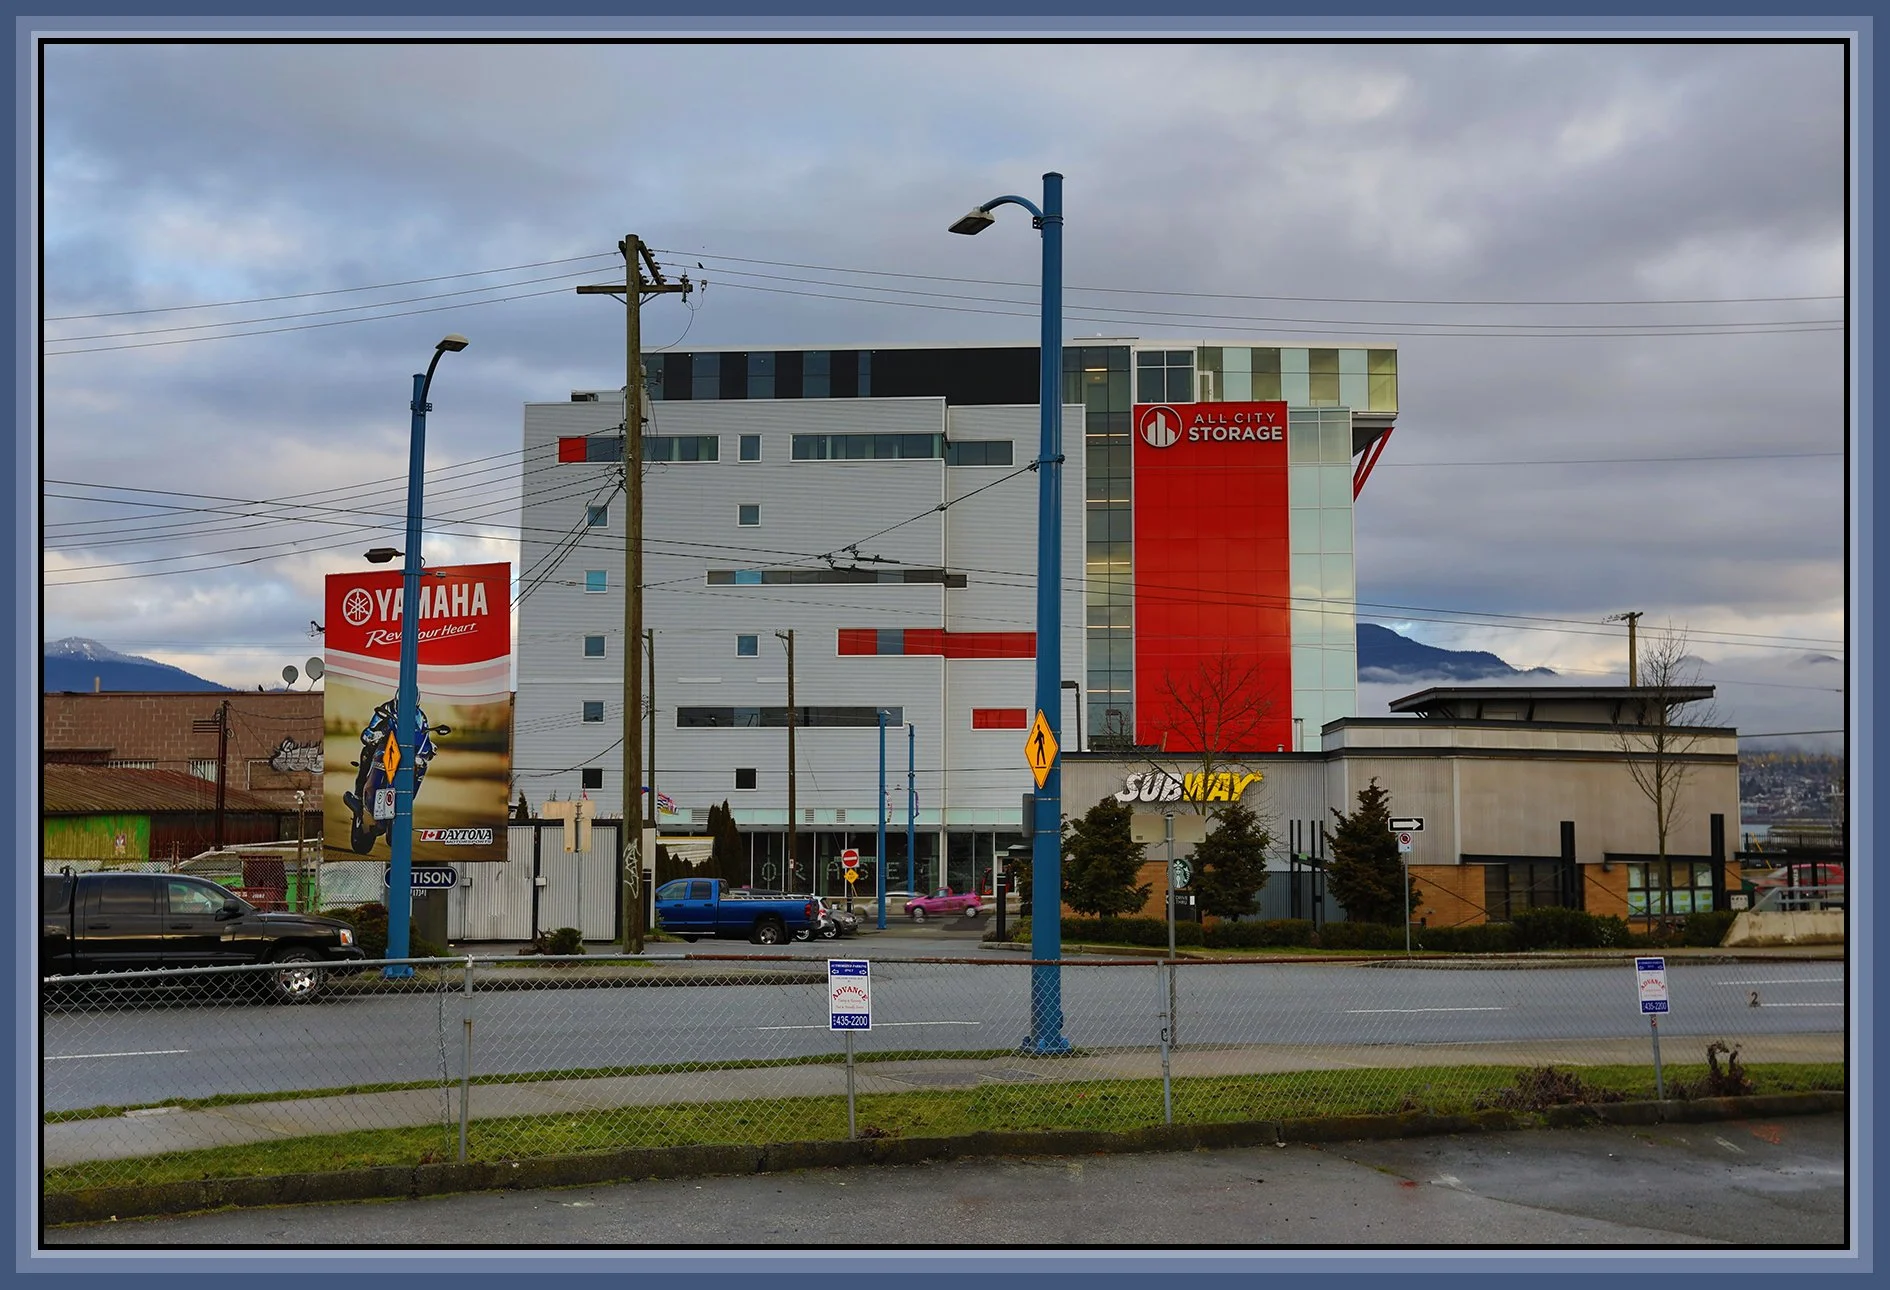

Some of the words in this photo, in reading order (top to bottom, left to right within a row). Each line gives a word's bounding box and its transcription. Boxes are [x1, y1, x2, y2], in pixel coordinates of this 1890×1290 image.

[1194, 413, 1227, 424] ALL
[1234, 412, 1276, 423] CITY
[1188, 425, 1283, 441] STORAGE
[375, 582, 488, 622] YAMAHA
[418, 627, 441, 640] our
[442, 623, 476, 636] Heart
[1115, 770, 1263, 803] SUBWAY
[438, 830, 492, 840] DAYTONA
[411, 872, 452, 884] TISON
[832, 986, 869, 1001] ADVANCE
[1644, 1002, 1667, 1010] 435-2200
[836, 1015, 868, 1026] 435-2200
